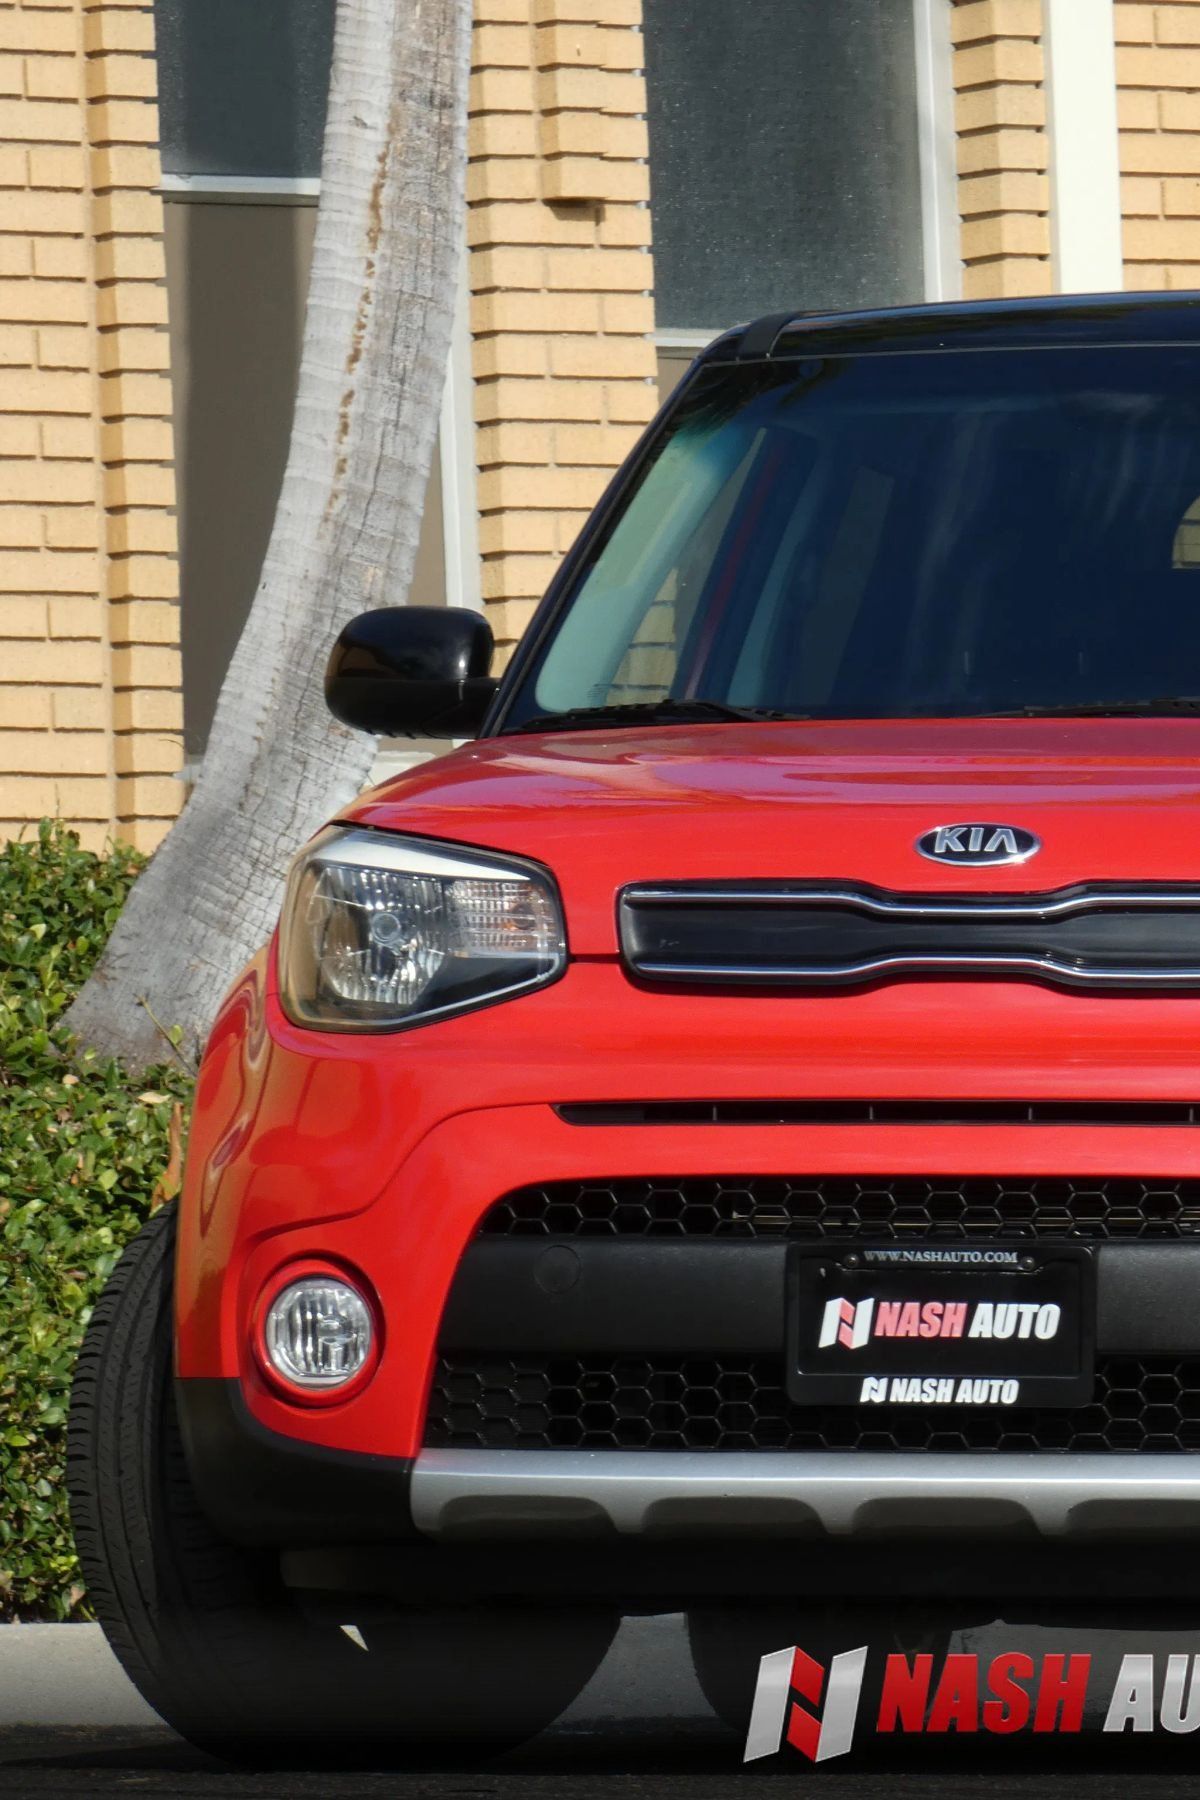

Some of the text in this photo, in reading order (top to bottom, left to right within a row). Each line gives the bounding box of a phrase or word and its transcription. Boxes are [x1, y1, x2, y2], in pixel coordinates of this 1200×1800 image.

[934, 827, 1019, 853] KIA
[863, 1250, 1018, 1263] WWW.NASHAUTO.COM
[874, 1301, 969, 1338] NASH
[967, 1302, 1062, 1340] AUTO
[889, 1377, 955, 1403] NASH
[954, 1378, 1020, 1404] AUTO
